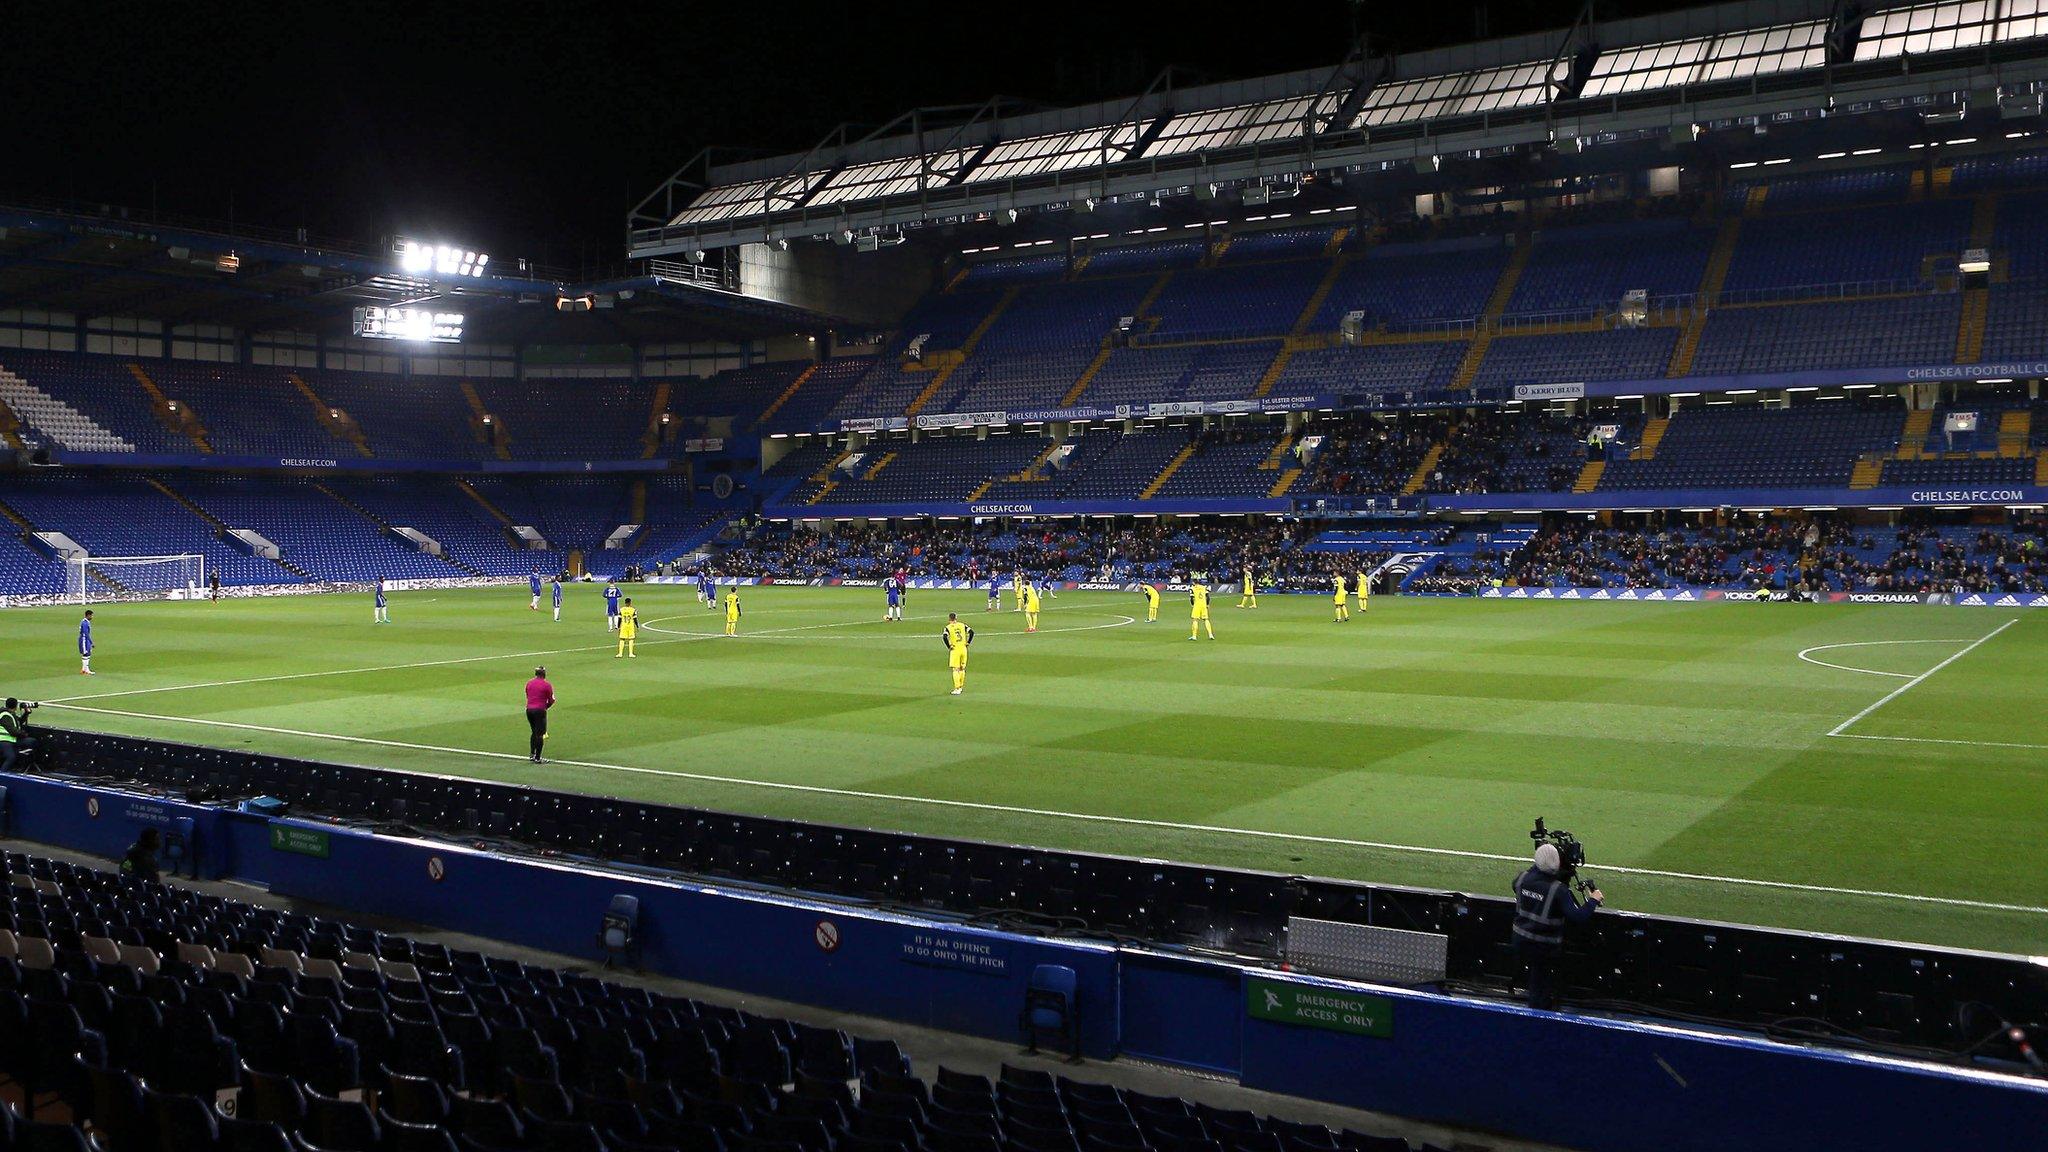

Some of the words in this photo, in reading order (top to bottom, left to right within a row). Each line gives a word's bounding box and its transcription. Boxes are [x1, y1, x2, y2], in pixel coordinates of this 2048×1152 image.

[1907, 368, 1962, 378] CHELSEA
[1966, 363, 2031, 376] FOOTBALL
[1557, 386, 1580, 394] BLUES
[1007, 413, 1038, 421] CHELSEA
[1039, 410, 1077, 419] FOOTBALL
[1078, 408, 1098, 417] CLUB
[608, 588, 617, 597] 27
[1850, 594, 1919, 603] YOKOHAMA
[954, 631, 963, 642] 3
[915, 935, 922, 944] IT
[925, 937, 932, 945] IS
[936, 939, 948, 948] AN
[953, 941, 991, 954] OFFENCE
[904, 945, 914, 954] TO
[917, 948, 930, 957] GO
[934, 949, 957, 960] ONTO
[961, 953, 977, 964] THE
[980, 957, 1005, 968] PITCH
[1296, 994, 1365, 1012] EMERGENCY
[1296, 1008, 1338, 1021] ACCESS
[1343, 1014, 1374, 1027] ONLY
[225, 1099, 235, 1116] 9
